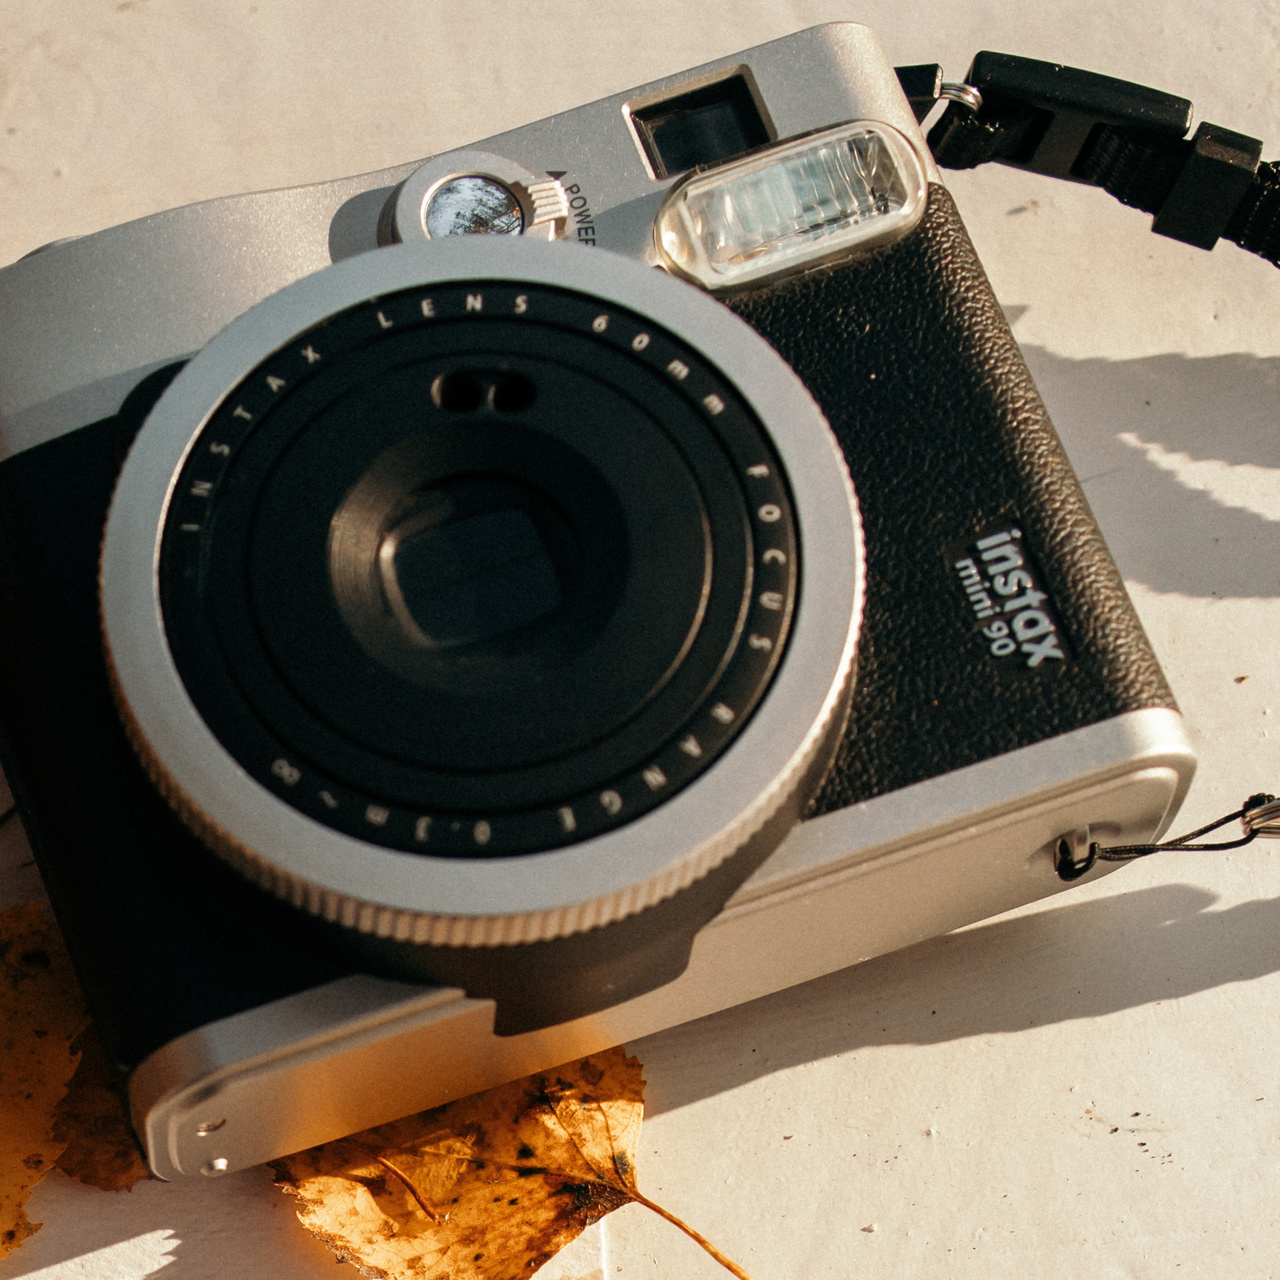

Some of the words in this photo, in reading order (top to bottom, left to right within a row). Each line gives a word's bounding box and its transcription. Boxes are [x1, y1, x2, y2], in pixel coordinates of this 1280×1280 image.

[376, 294, 528, 329] LENS
[591, 314, 725, 416] 60mm
[181, 344, 321, 532] INSTAX
[745, 463, 787, 651] FOCUS
[955, 557, 1002, 619] mini
[982, 620, 1017, 657] 90
[976, 527, 1065, 668] instax
[558, 702, 736, 833] RANGE
